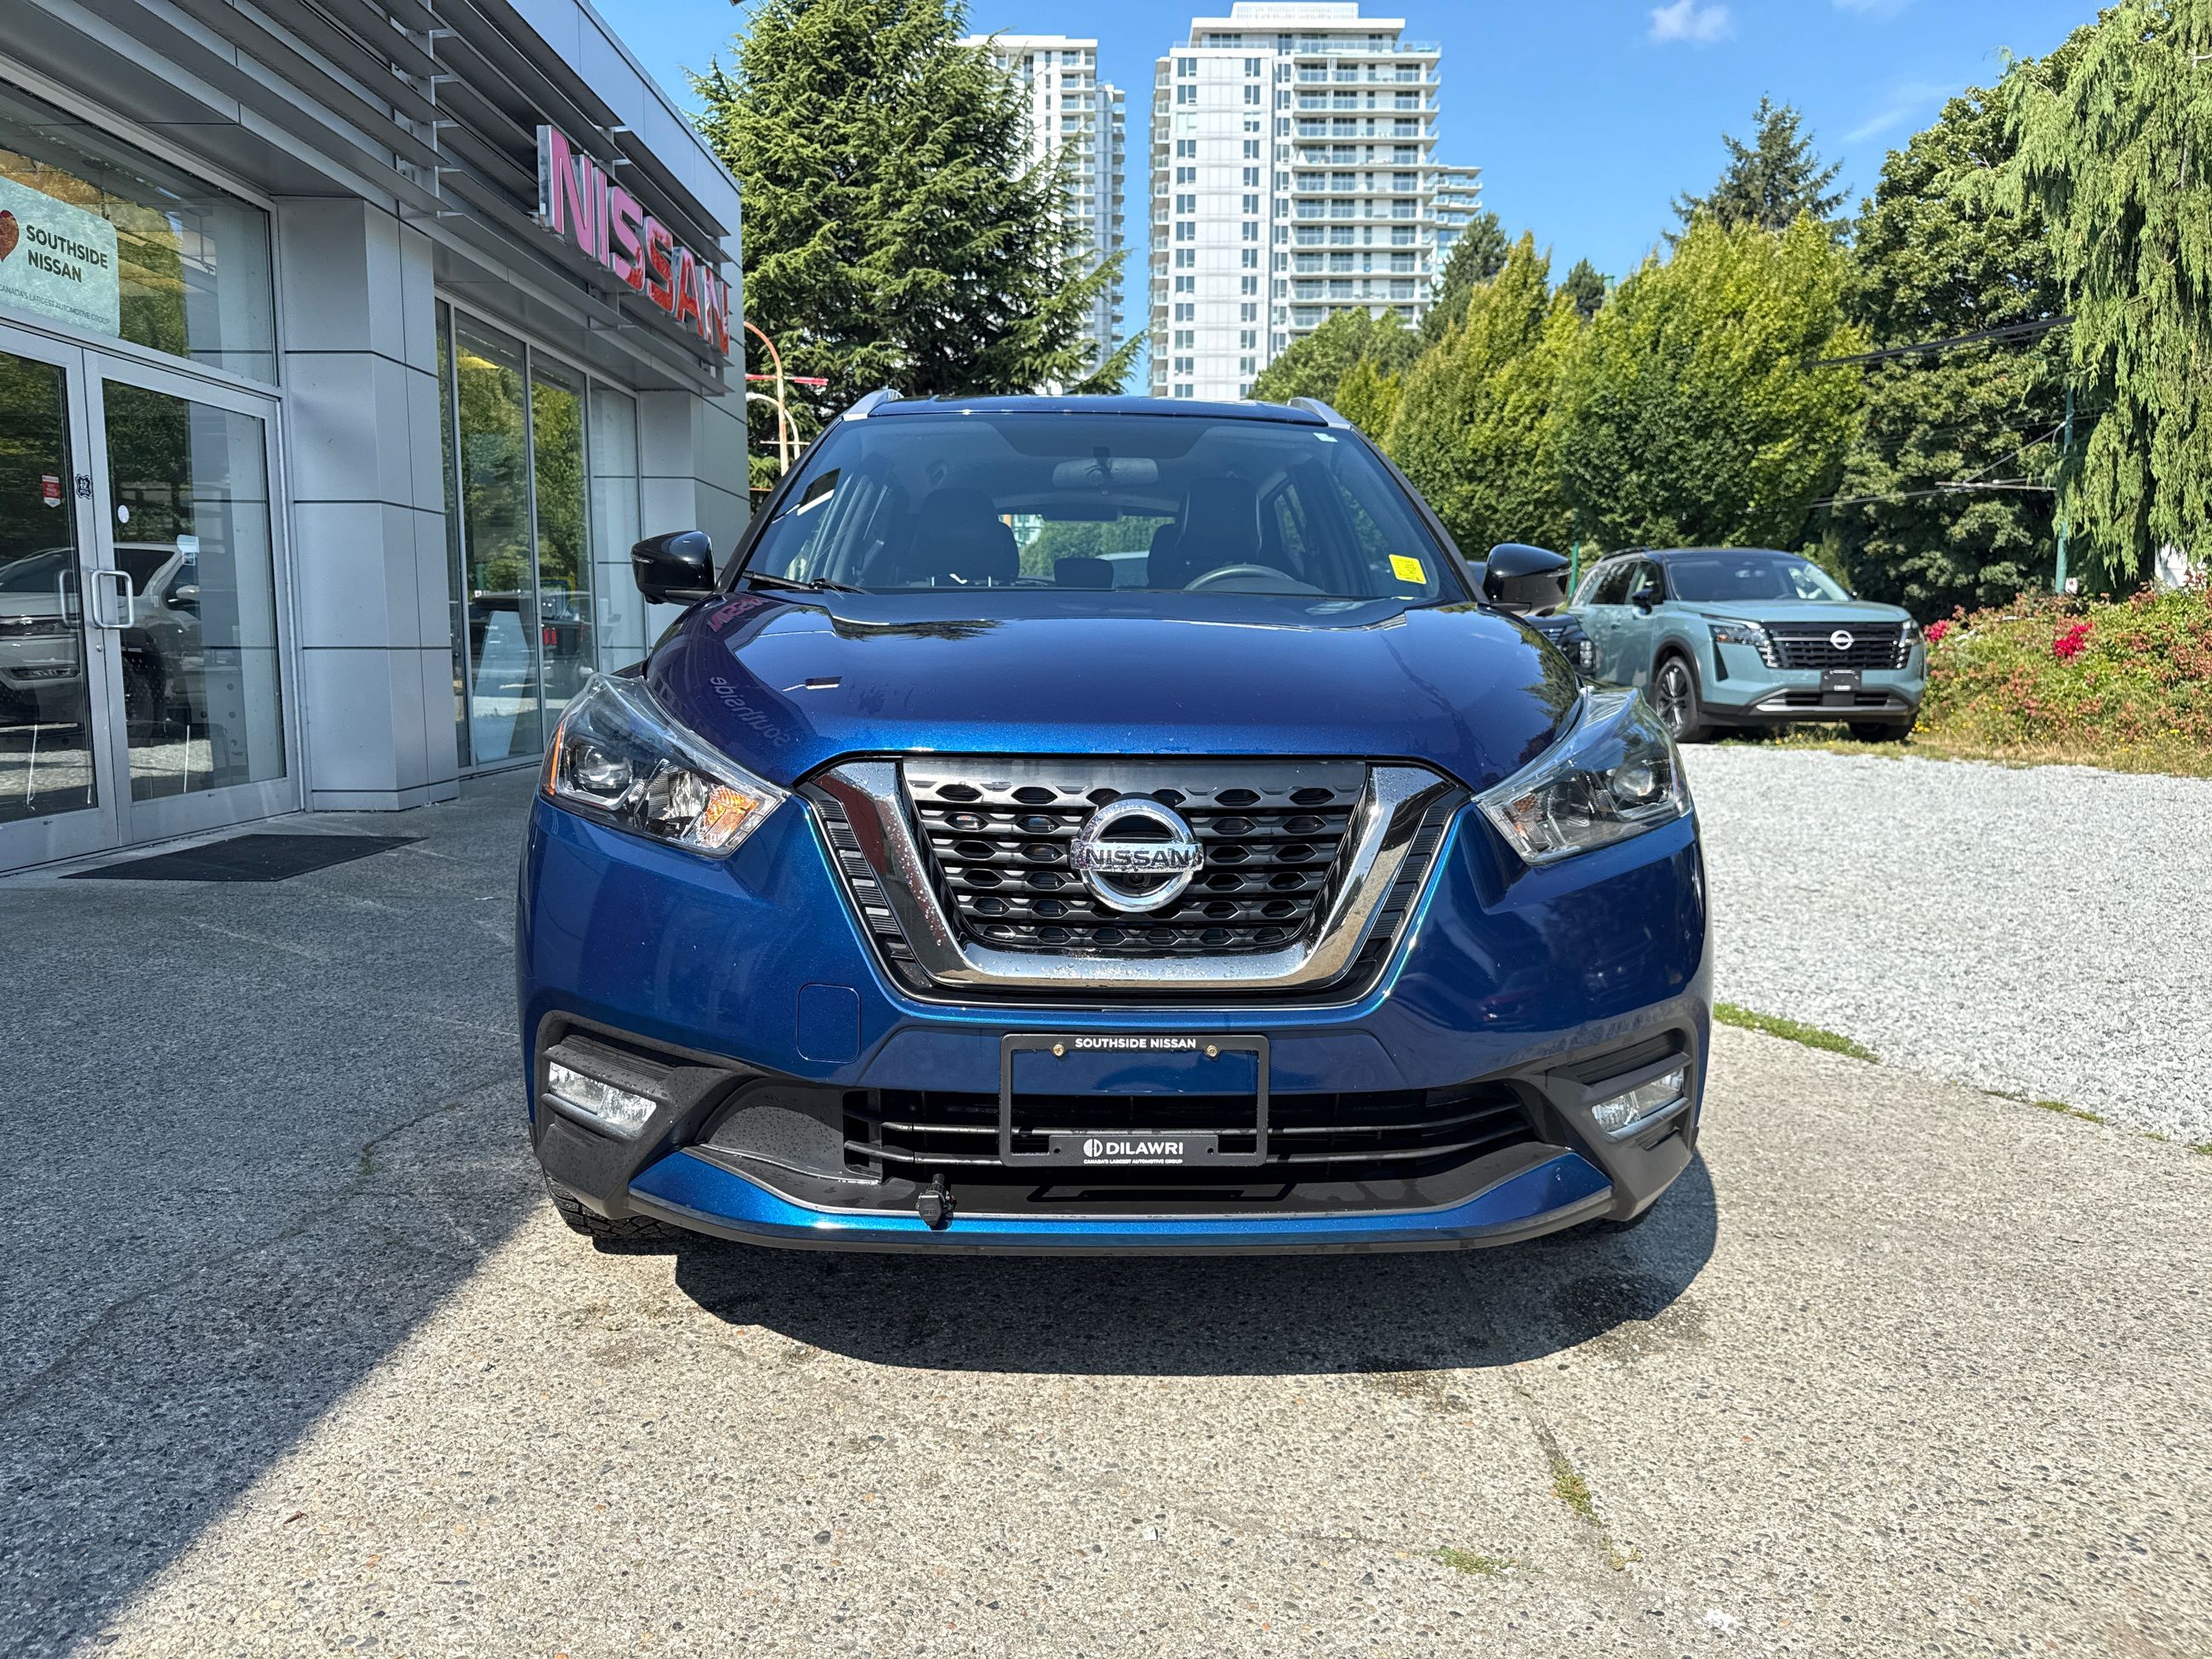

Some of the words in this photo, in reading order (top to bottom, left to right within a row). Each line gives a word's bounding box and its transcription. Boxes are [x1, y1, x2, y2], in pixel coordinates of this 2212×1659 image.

[26, 225, 108, 269] SOUTHSIDE
[538, 125, 729, 355] NISSAN
[28, 249, 82, 283] NISSAN
[1086, 850, 1189, 866] NISSAN
[1075, 1038, 1147, 1048] SOUTHSIDE
[1150, 1038, 1196, 1049] NISSAN
[1106, 1142, 1183, 1154] DILAWRI
